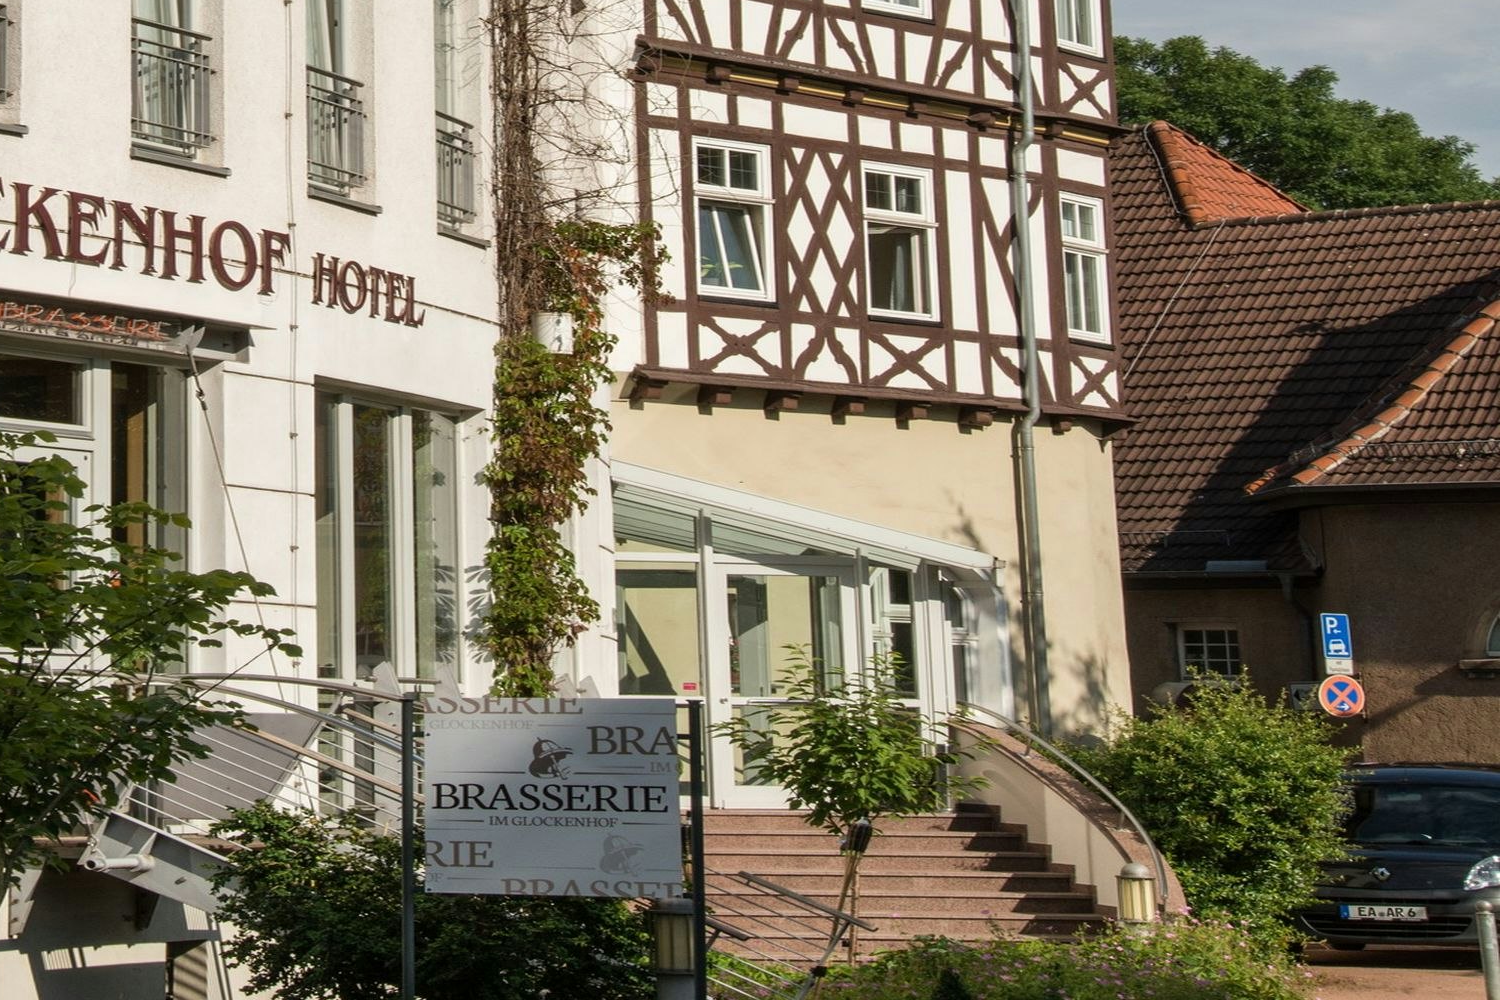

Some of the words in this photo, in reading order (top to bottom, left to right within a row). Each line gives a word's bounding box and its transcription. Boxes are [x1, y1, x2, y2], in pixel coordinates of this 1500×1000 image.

[310, 251, 426, 329] HOTEL
[1325, 616, 1338, 634] P
[428, 719, 534, 731] GLOCKENHOF
[586, 725, 678, 755] BRA
[431, 783, 669, 813] BRASSERIE
[489, 815, 508, 826] IM
[511, 816, 619, 828] GLOCKENHOF
[1357, 906, 1376, 917] EA
[1386, 907, 1404, 918] AR
[1407, 907, 1417, 918] 6
